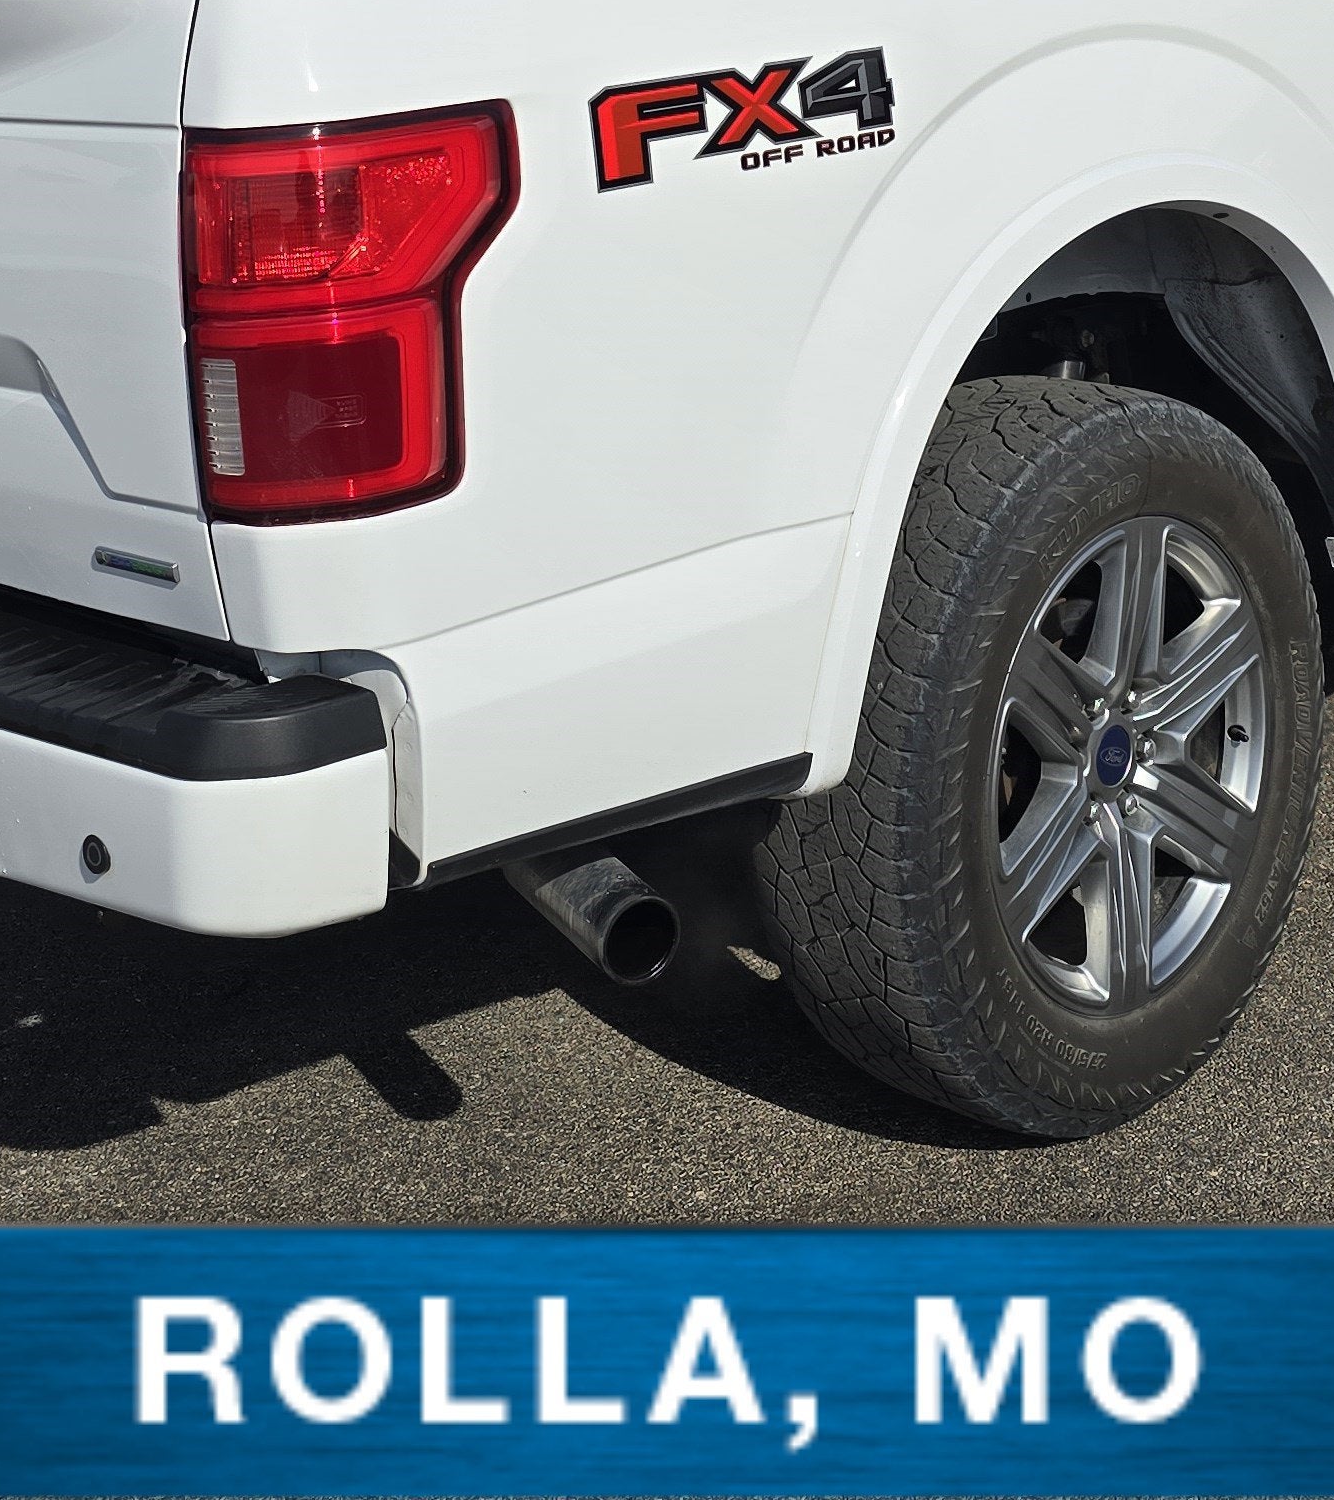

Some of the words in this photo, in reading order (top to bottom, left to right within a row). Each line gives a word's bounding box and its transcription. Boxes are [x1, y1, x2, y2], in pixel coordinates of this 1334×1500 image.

[588, 46, 895, 193] FX4
[740, 144, 804, 172] OFF
[815, 128, 896, 158] ROAD
[1038, 473, 1142, 583] KUMHO
[1274, 639, 1313, 872] ROADVENTURE
